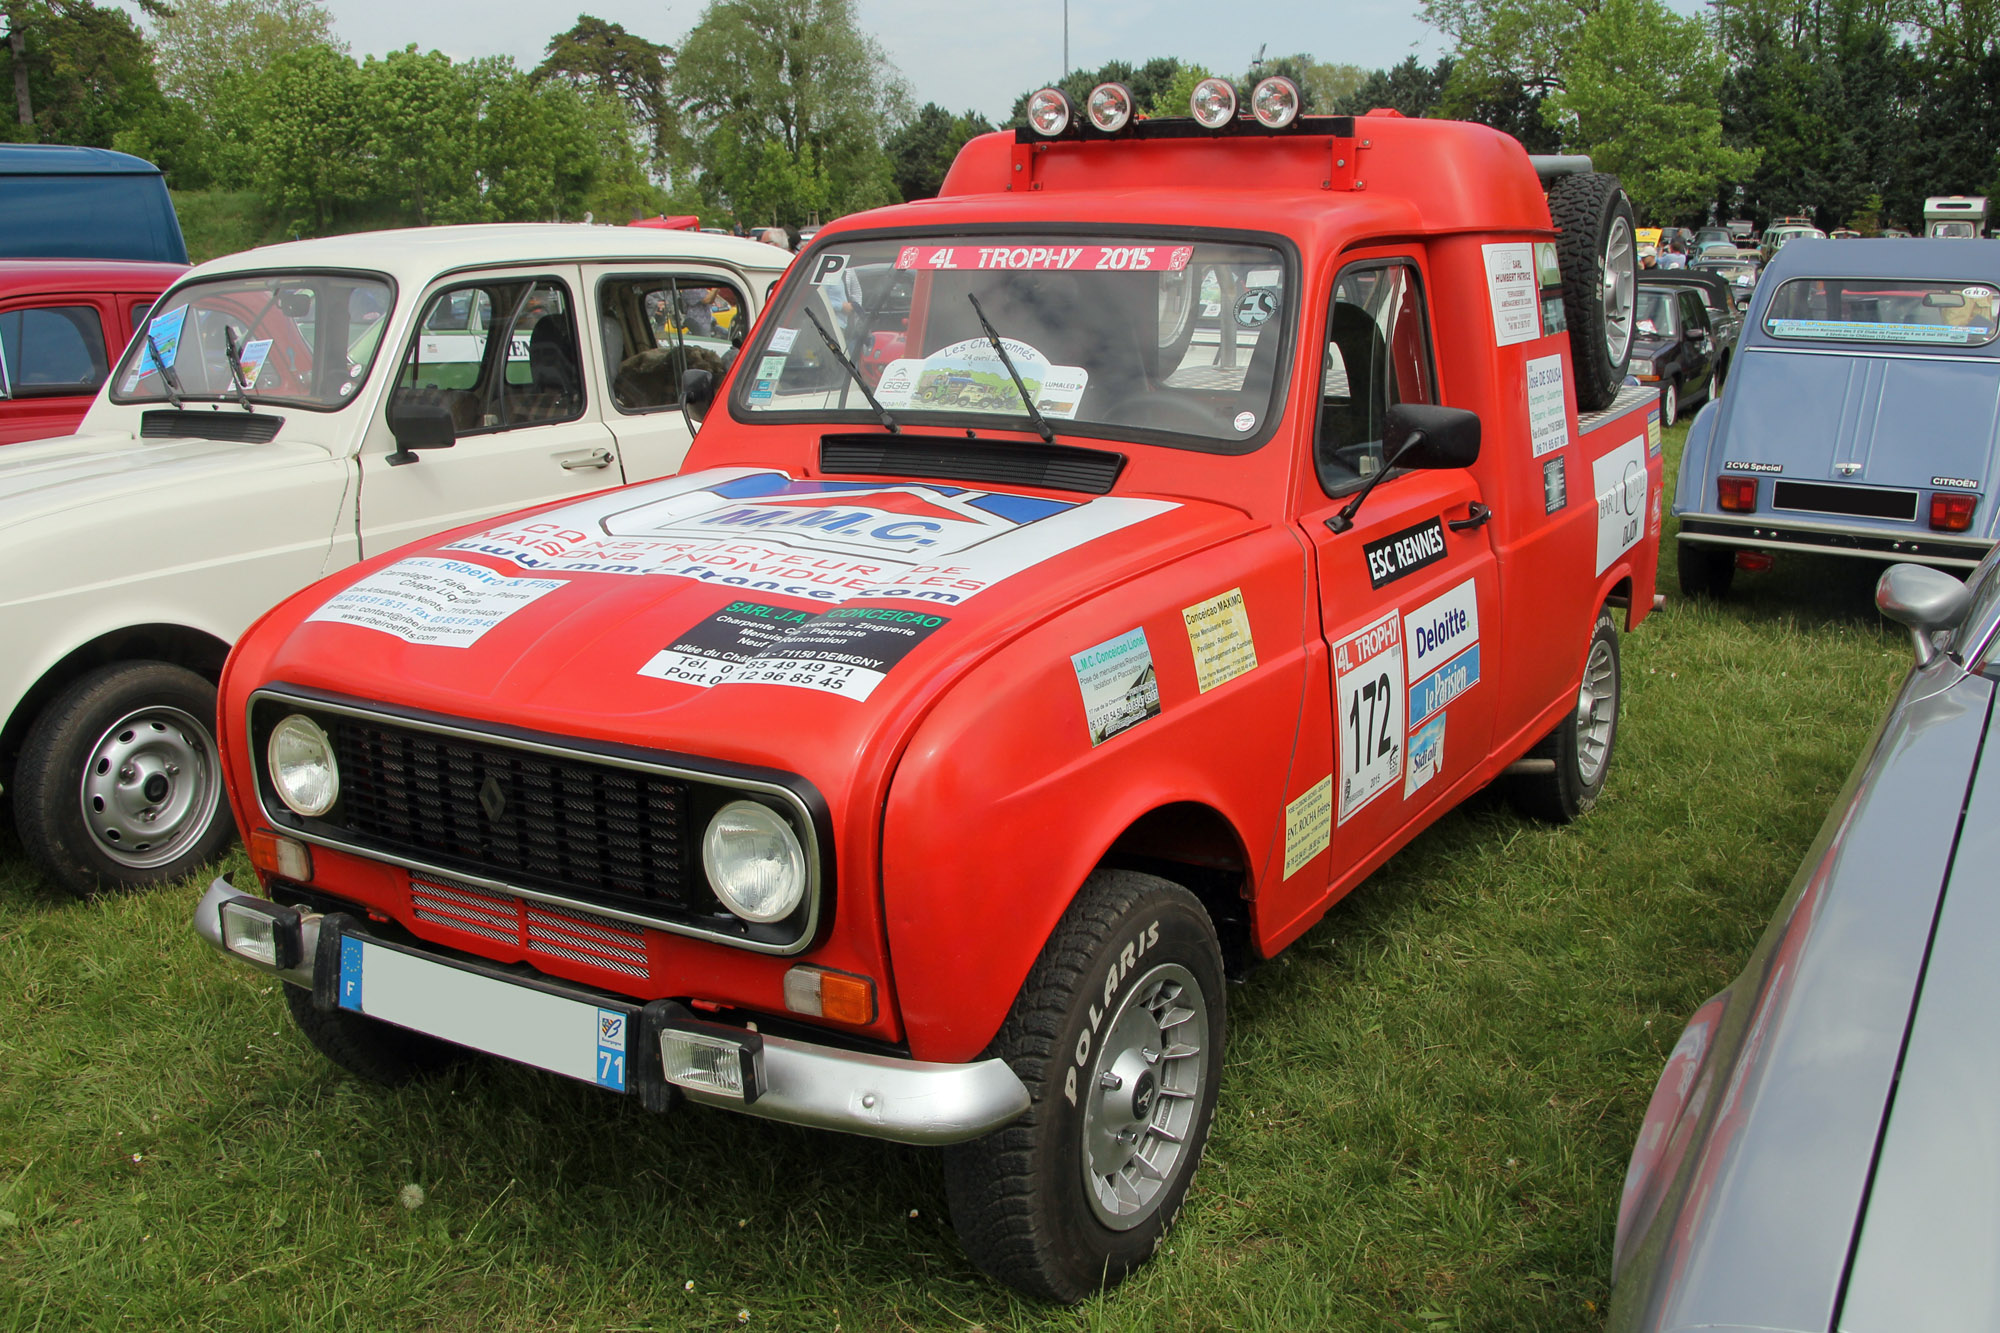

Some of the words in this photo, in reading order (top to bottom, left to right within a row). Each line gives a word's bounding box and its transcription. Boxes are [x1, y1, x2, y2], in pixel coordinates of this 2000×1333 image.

[814, 255, 845, 283] P
[929, 248, 957, 269] 4L
[978, 247, 1084, 269] TROPHY
[1095, 247, 1155, 269] 2015
[1495, 272, 1516, 282] HUMBERT
[944, 343, 966, 357] Les
[970, 339, 1036, 361] Cheronnés
[883, 381, 911, 389] GGB
[1538, 370, 1546, 386] DE
[1545, 367, 1561, 384] SOUSA
[1750, 463, 1782, 473] Spécial
[1932, 476, 1977, 488] CITROËN
[1600, 493, 1614, 520] BAR
[699, 509, 942, 546] M.M.C.
[480, 531, 645, 561] MAISONS
[1368, 545, 1395, 581] ESC
[1394, 525, 1444, 570] RENNES
[438, 561, 504, 586] Ribeiro
[524, 579, 560, 589] Fils
[909, 565, 971, 575] DE
[381, 570, 432, 580] Carrelage
[492, 591, 530, 600] Pierre
[399, 579, 437, 591] Chape
[436, 588, 481, 605] Liquide
[410, 606, 431, 620] Fax
[416, 595, 444, 612] Noirots
[726, 602, 774, 618] SARL
[774, 610, 808, 624] J.A.
[827, 608, 942, 628] CONCEICAO
[1185, 606, 1217, 625] Conceicao
[1217, 593, 1242, 611] MAXIMO
[716, 615, 775, 631] Charpente
[855, 622, 916, 637] Zinguerie
[811, 628, 867, 638] Plaquiste
[737, 637, 768, 648] Neuf
[781, 635, 847, 645] Rénovation
[1074, 655, 1096, 673] L.M.C.
[1095, 643, 1127, 663] Conceicao
[1126, 633, 1145, 650] Lionel
[1338, 645, 1353, 673] 4L
[1354, 615, 1398, 664] TROPHY
[673, 643, 702, 654] allée
[703, 648, 721, 658] du
[780, 650, 816, 659] 71150
[816, 650, 884, 669] DEMIGNY
[677, 656, 708, 670] Tél.
[745, 660, 769, 670] 85
[772, 661, 797, 670] 49
[800, 661, 825, 673] 49
[828, 665, 855, 678] 21
[664, 667, 706, 683] Port
[737, 671, 758, 680] 12
[761, 672, 786, 681] 96
[789, 673, 816, 684] 85
[818, 677, 846, 690] 45
[1079, 675, 1092, 685] Pose
[1092, 672, 1099, 680] de
[1424, 687, 1435, 715] Le
[1434, 664, 1467, 707] Parisien
[1090, 720, 1096, 730] 06
[1097, 717, 1102, 726] 13
[1350, 673, 1391, 774] 172
[1298, 809, 1317, 832] ROCHA
[1316, 801, 1330, 817] Frères
[346, 981, 355, 997] F
[1064, 920, 1160, 1108] POLARIS
[600, 1050, 623, 1084] 71
